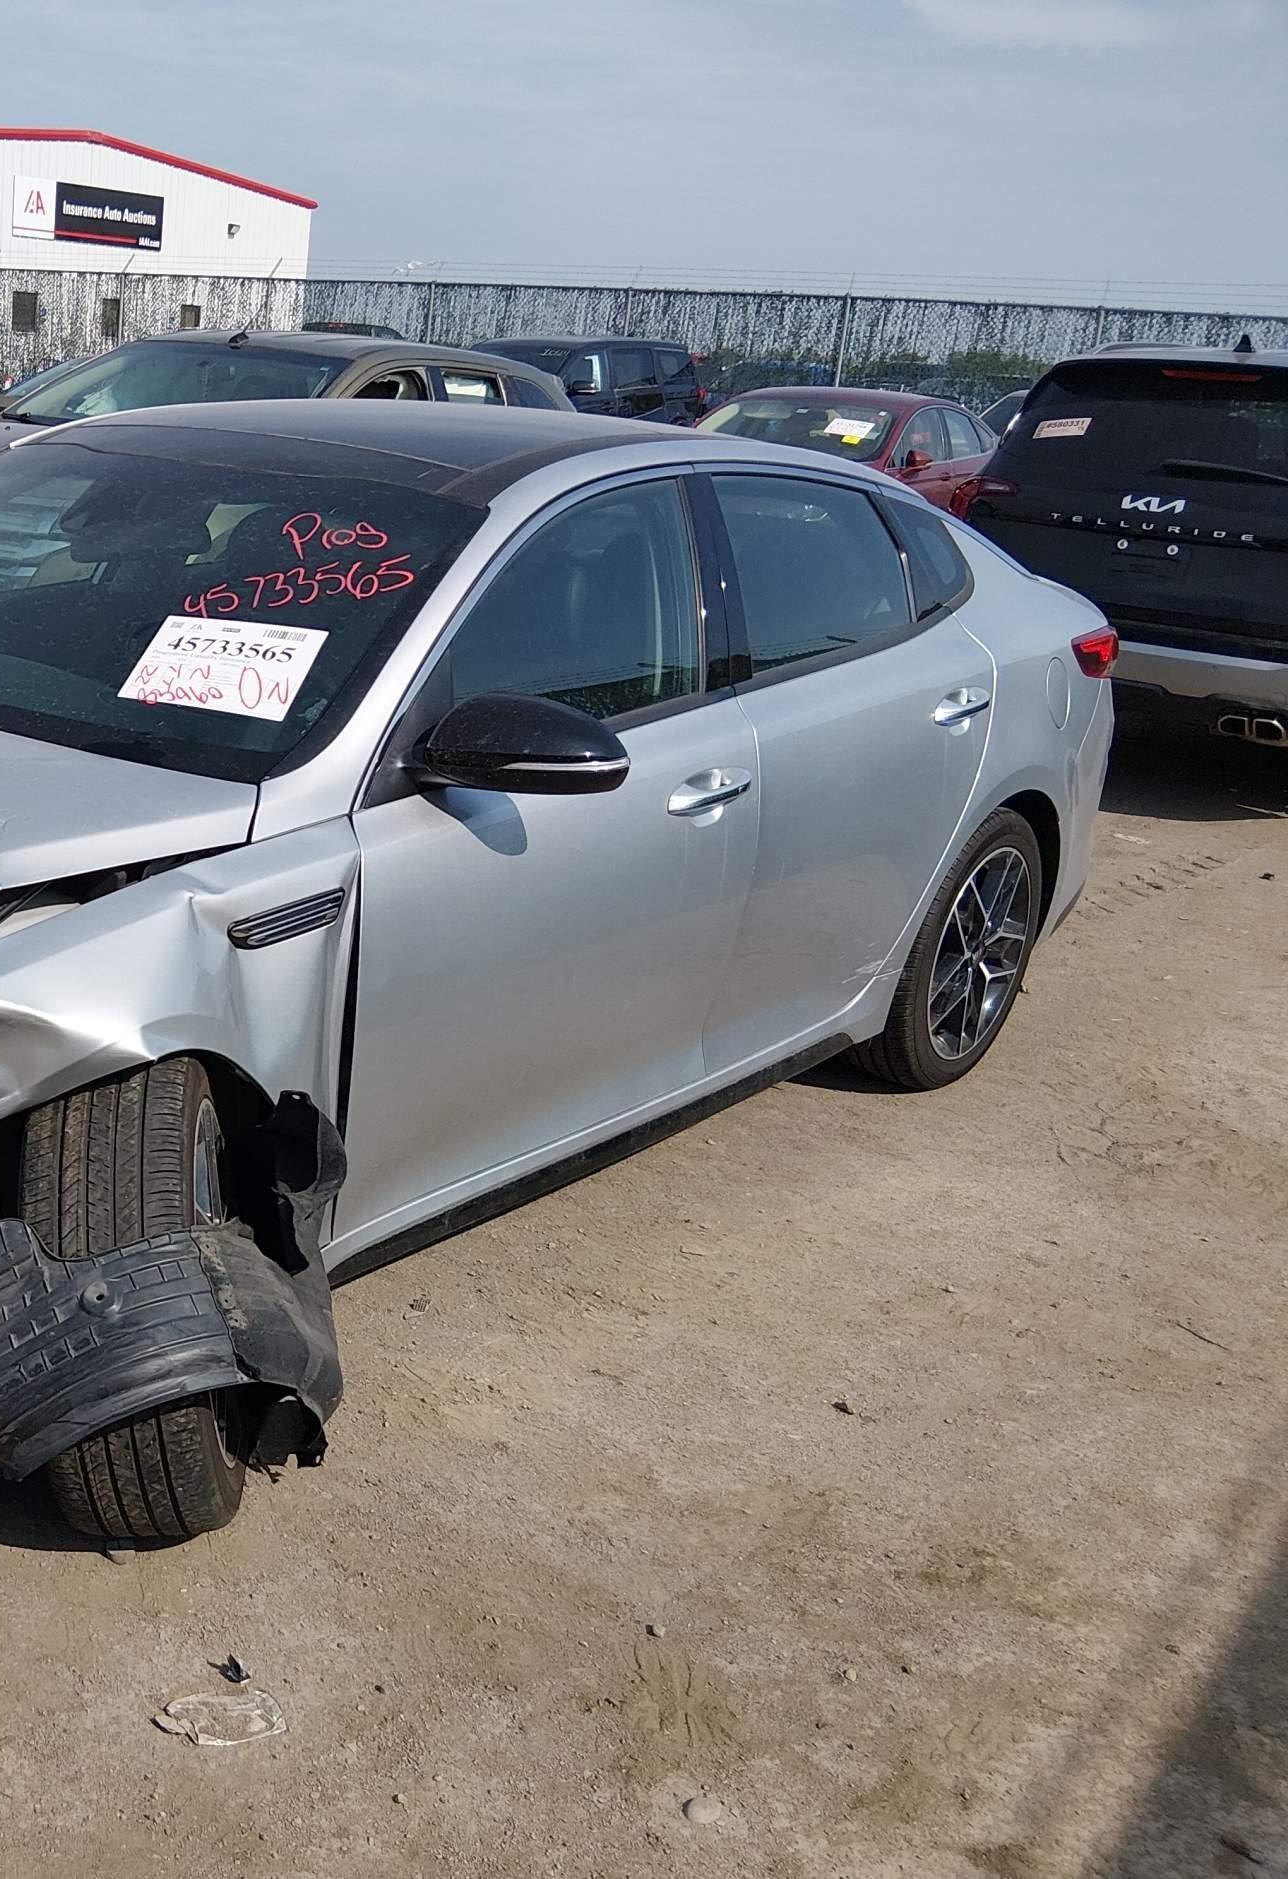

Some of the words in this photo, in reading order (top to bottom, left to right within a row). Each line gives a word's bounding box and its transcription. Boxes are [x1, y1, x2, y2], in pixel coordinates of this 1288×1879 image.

[62, 200, 102, 219] Insurance
[103, 206, 122, 221] Auto
[122, 208, 157, 226] Auctions
[1050, 512, 1255, 542] TELLURIDE
[167, 635, 297, 663] 45733565
